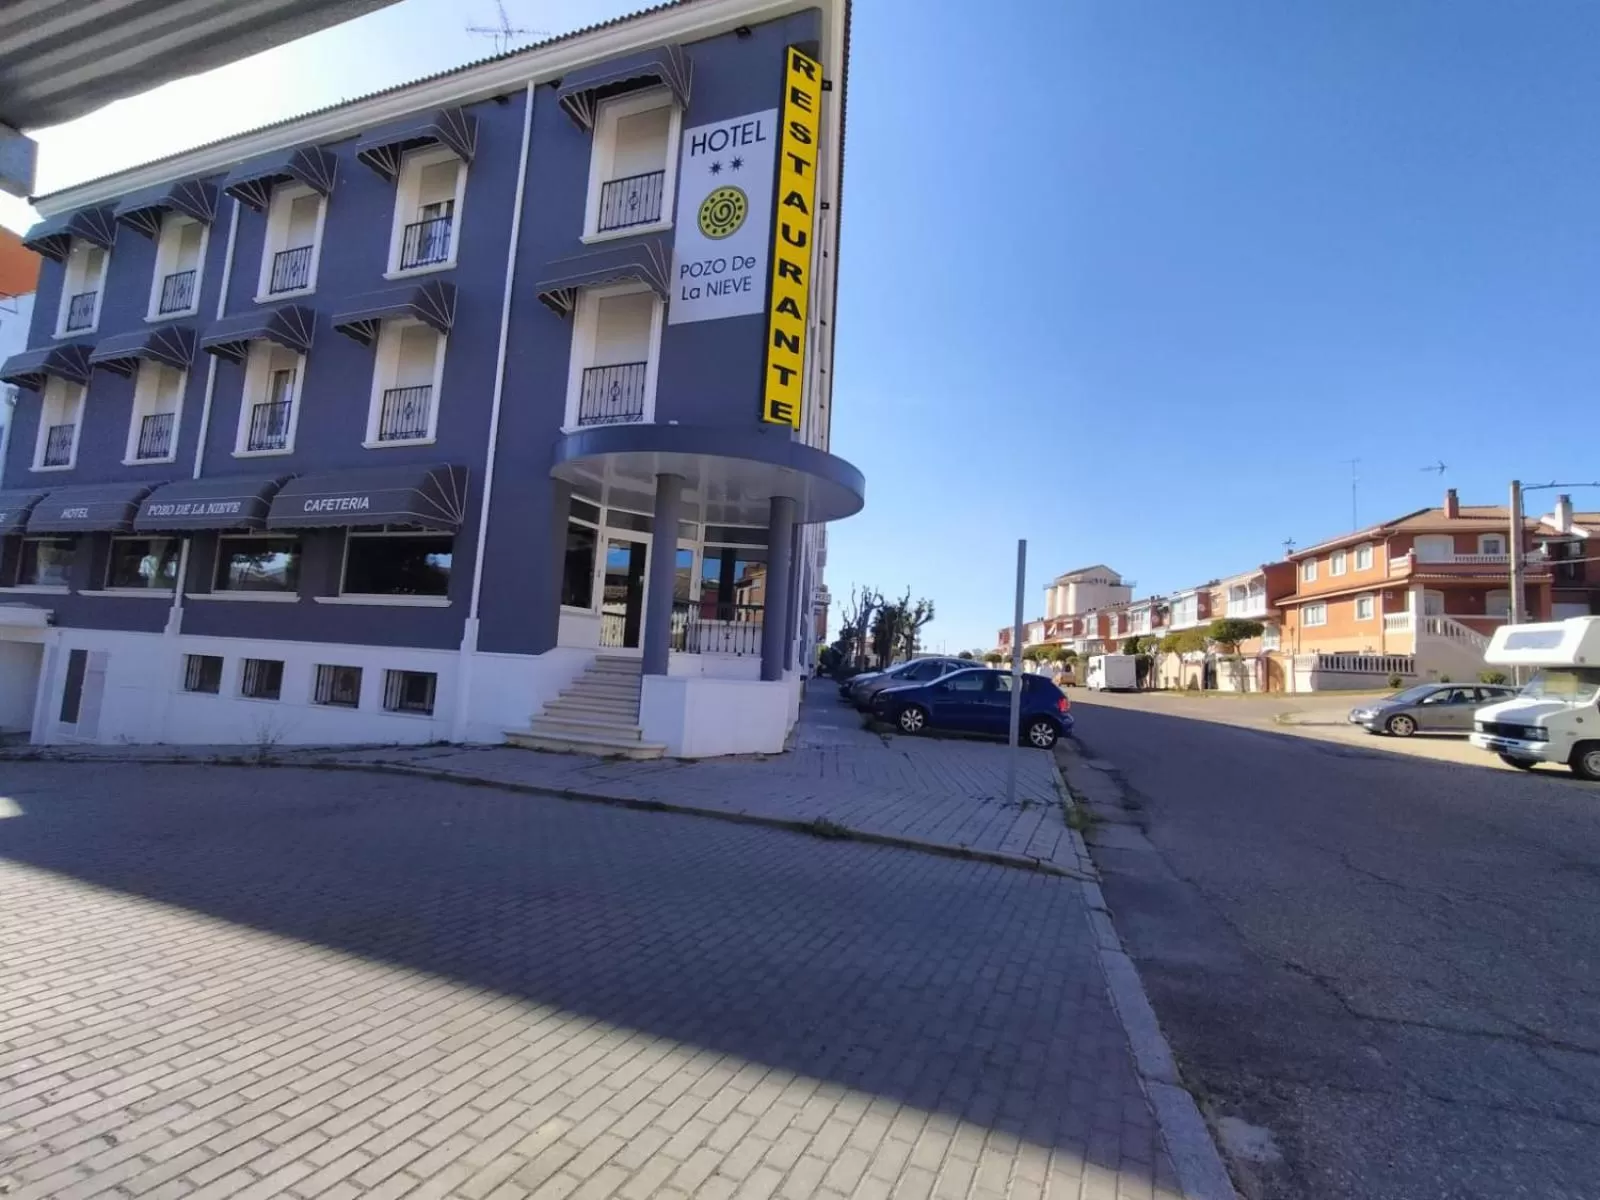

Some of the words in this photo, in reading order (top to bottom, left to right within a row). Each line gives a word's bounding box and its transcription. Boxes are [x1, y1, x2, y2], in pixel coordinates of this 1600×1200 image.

[691, 120, 766, 156] HOTEL
[770, 52, 816, 424] RESTAURANTE
[680, 258, 727, 279] POZO
[732, 255, 757, 271] De
[681, 285, 701, 301] La
[706, 275, 752, 297] NIEVE
[60, 507, 89, 519] HOTEL
[175, 503, 191, 516] DE
[190, 503, 206, 515] LA
[206, 501, 241, 514] NIEVE
[303, 496, 370, 512] CAFETERIA
